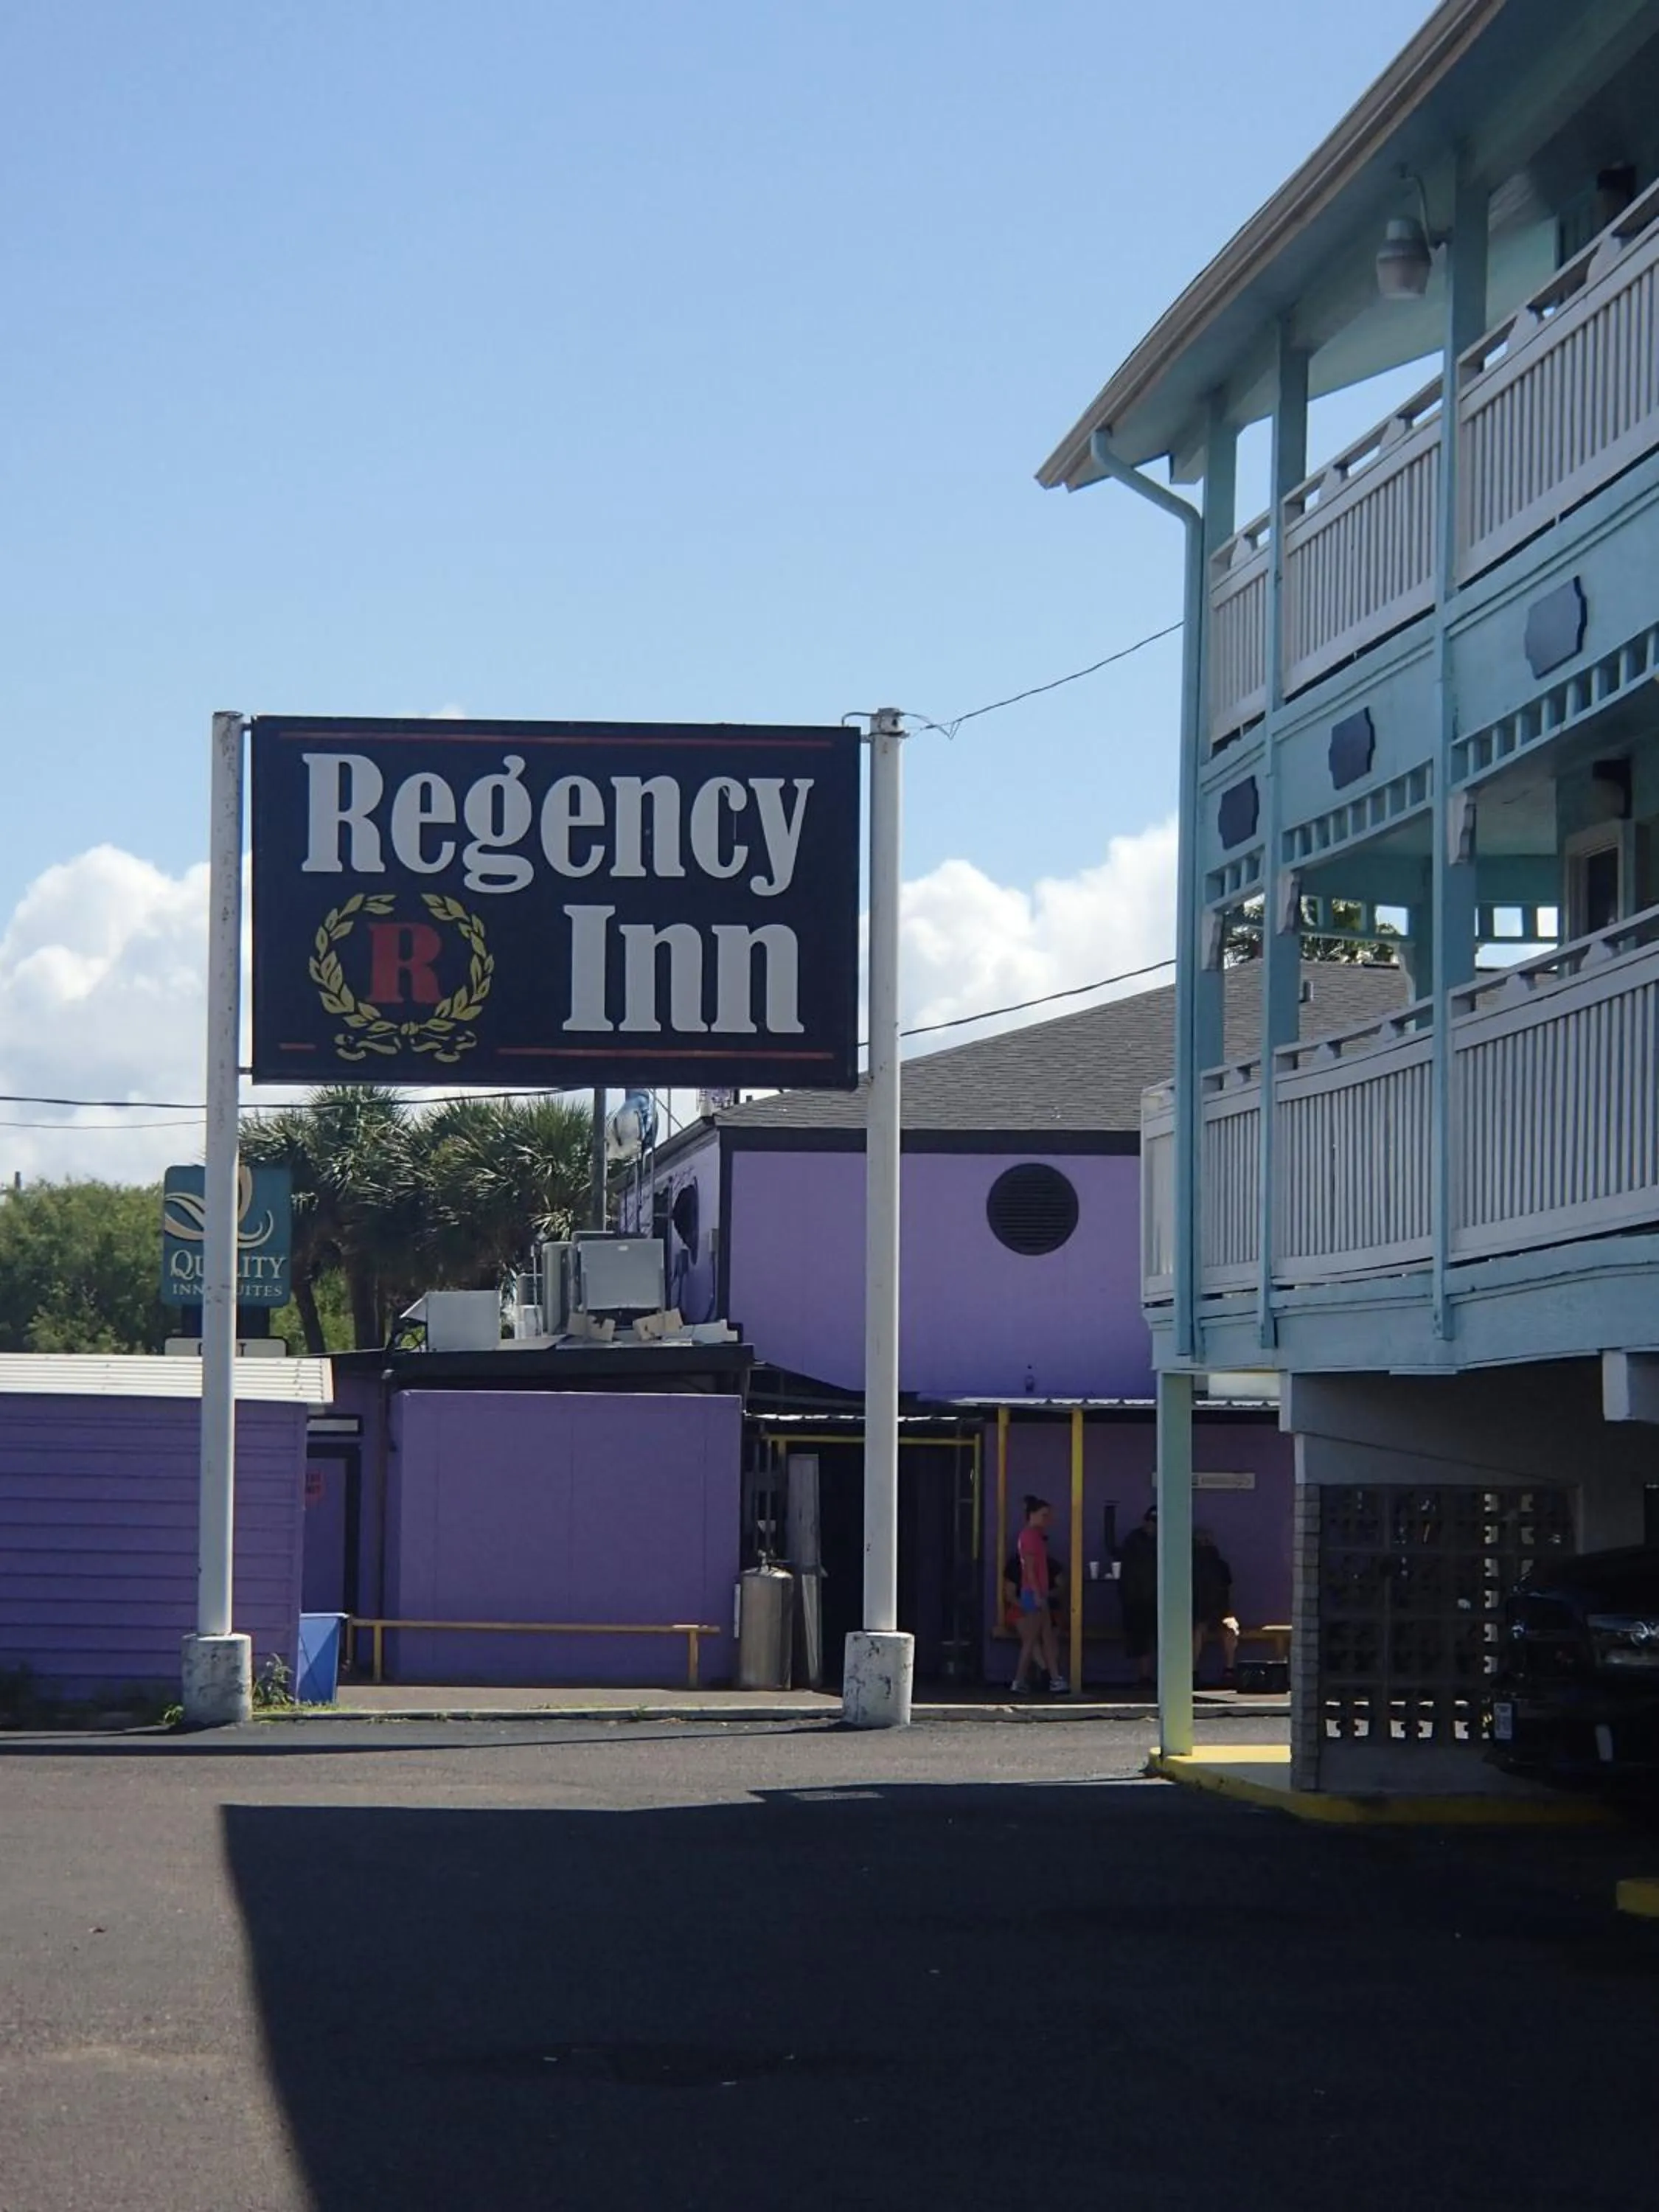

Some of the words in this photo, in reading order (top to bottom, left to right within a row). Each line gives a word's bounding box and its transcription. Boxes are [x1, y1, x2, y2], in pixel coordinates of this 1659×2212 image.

[302, 753, 815, 897] Regency
[366, 922, 443, 1004] R
[563, 905, 805, 1033] Inn
